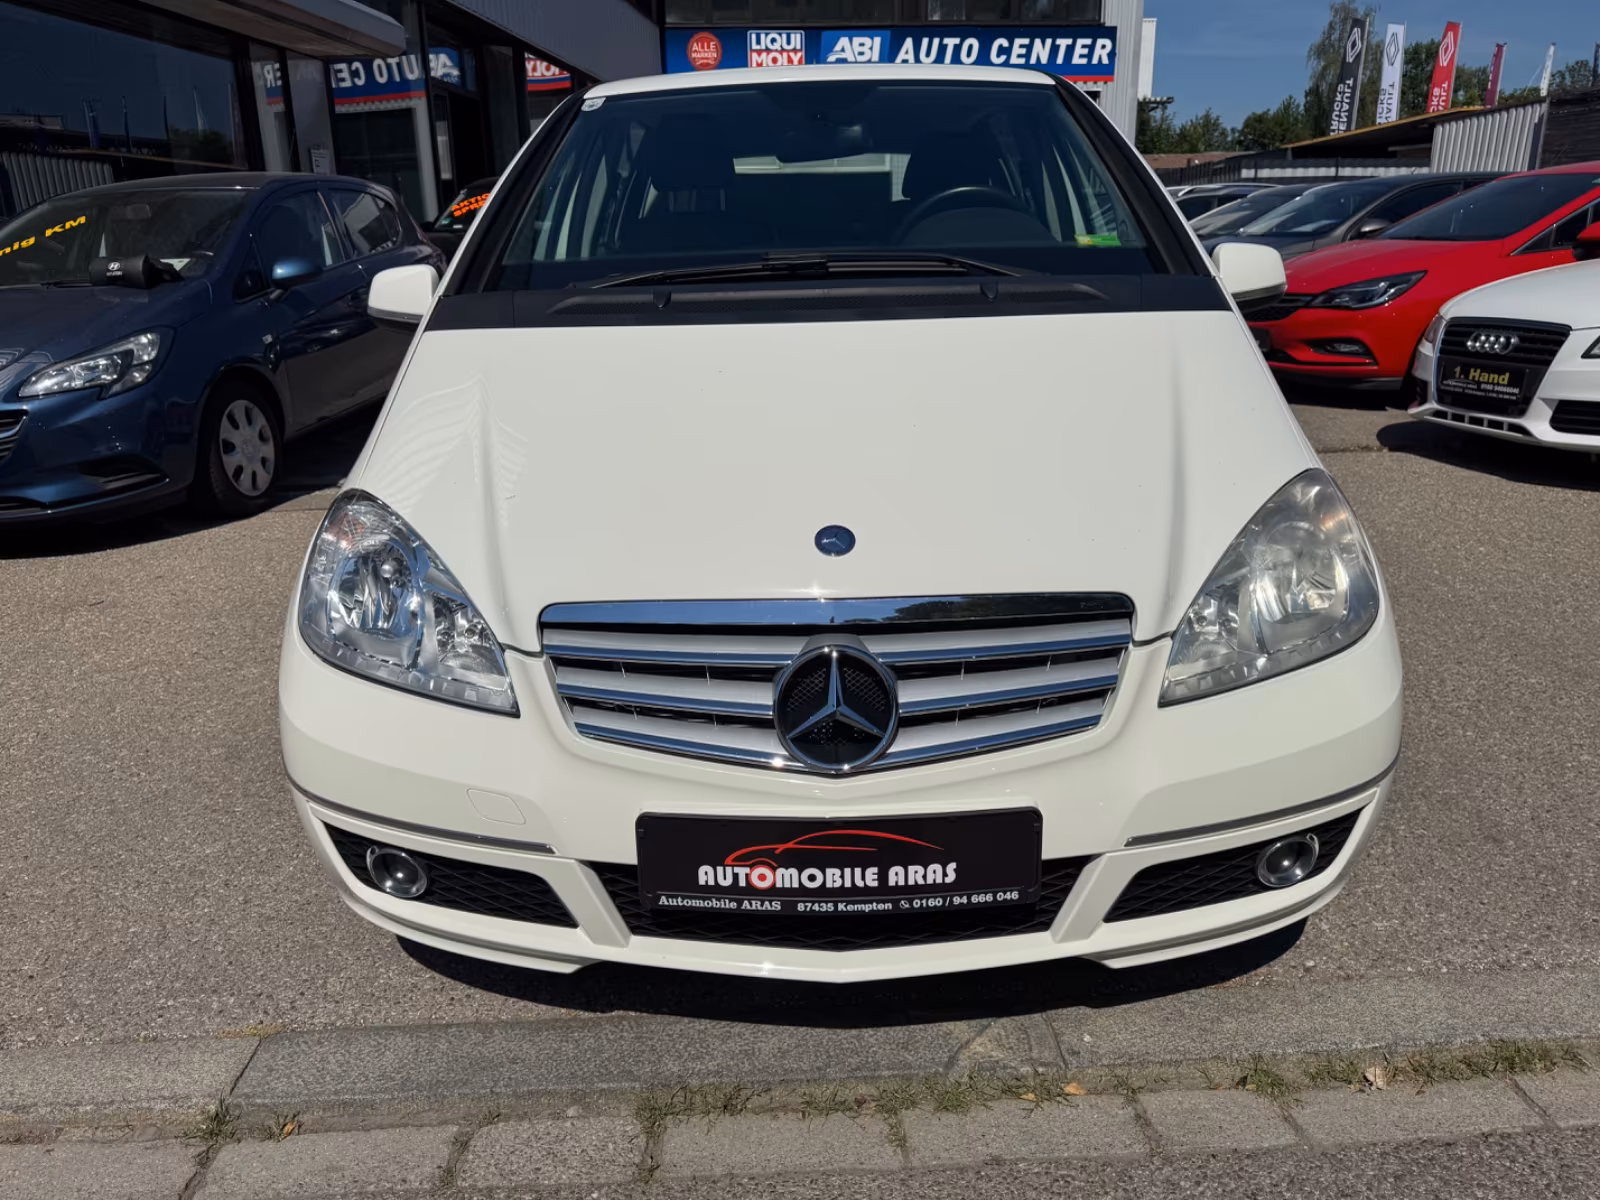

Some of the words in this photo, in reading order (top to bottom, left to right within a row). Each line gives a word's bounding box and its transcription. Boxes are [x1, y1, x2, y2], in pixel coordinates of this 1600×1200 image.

[691, 42, 717, 52] ALLE
[751, 33, 801, 50] LIQUI
[826, 36, 881, 63] ABI
[894, 37, 980, 64] AUTO
[989, 38, 1113, 65] CENTER
[752, 52, 803, 68] MOLY
[45, 215, 87, 237] KM
[1454, 366, 1465, 379] 1.
[1469, 367, 1510, 385] Hand
[697, 864, 879, 890] AUTOMOBILE
[888, 862, 957, 887] ARAS
[658, 895, 737, 909] Automobile
[741, 900, 782, 911] ARAS
[797, 902, 835, 912] 87435
[838, 902, 892, 912] Kempten
[912, 897, 943, 908] 0160
[945, 896, 950, 907] /
[952, 895, 968, 905] 94
[971, 893, 993, 903] 666
[996, 891, 1019, 901] 046
